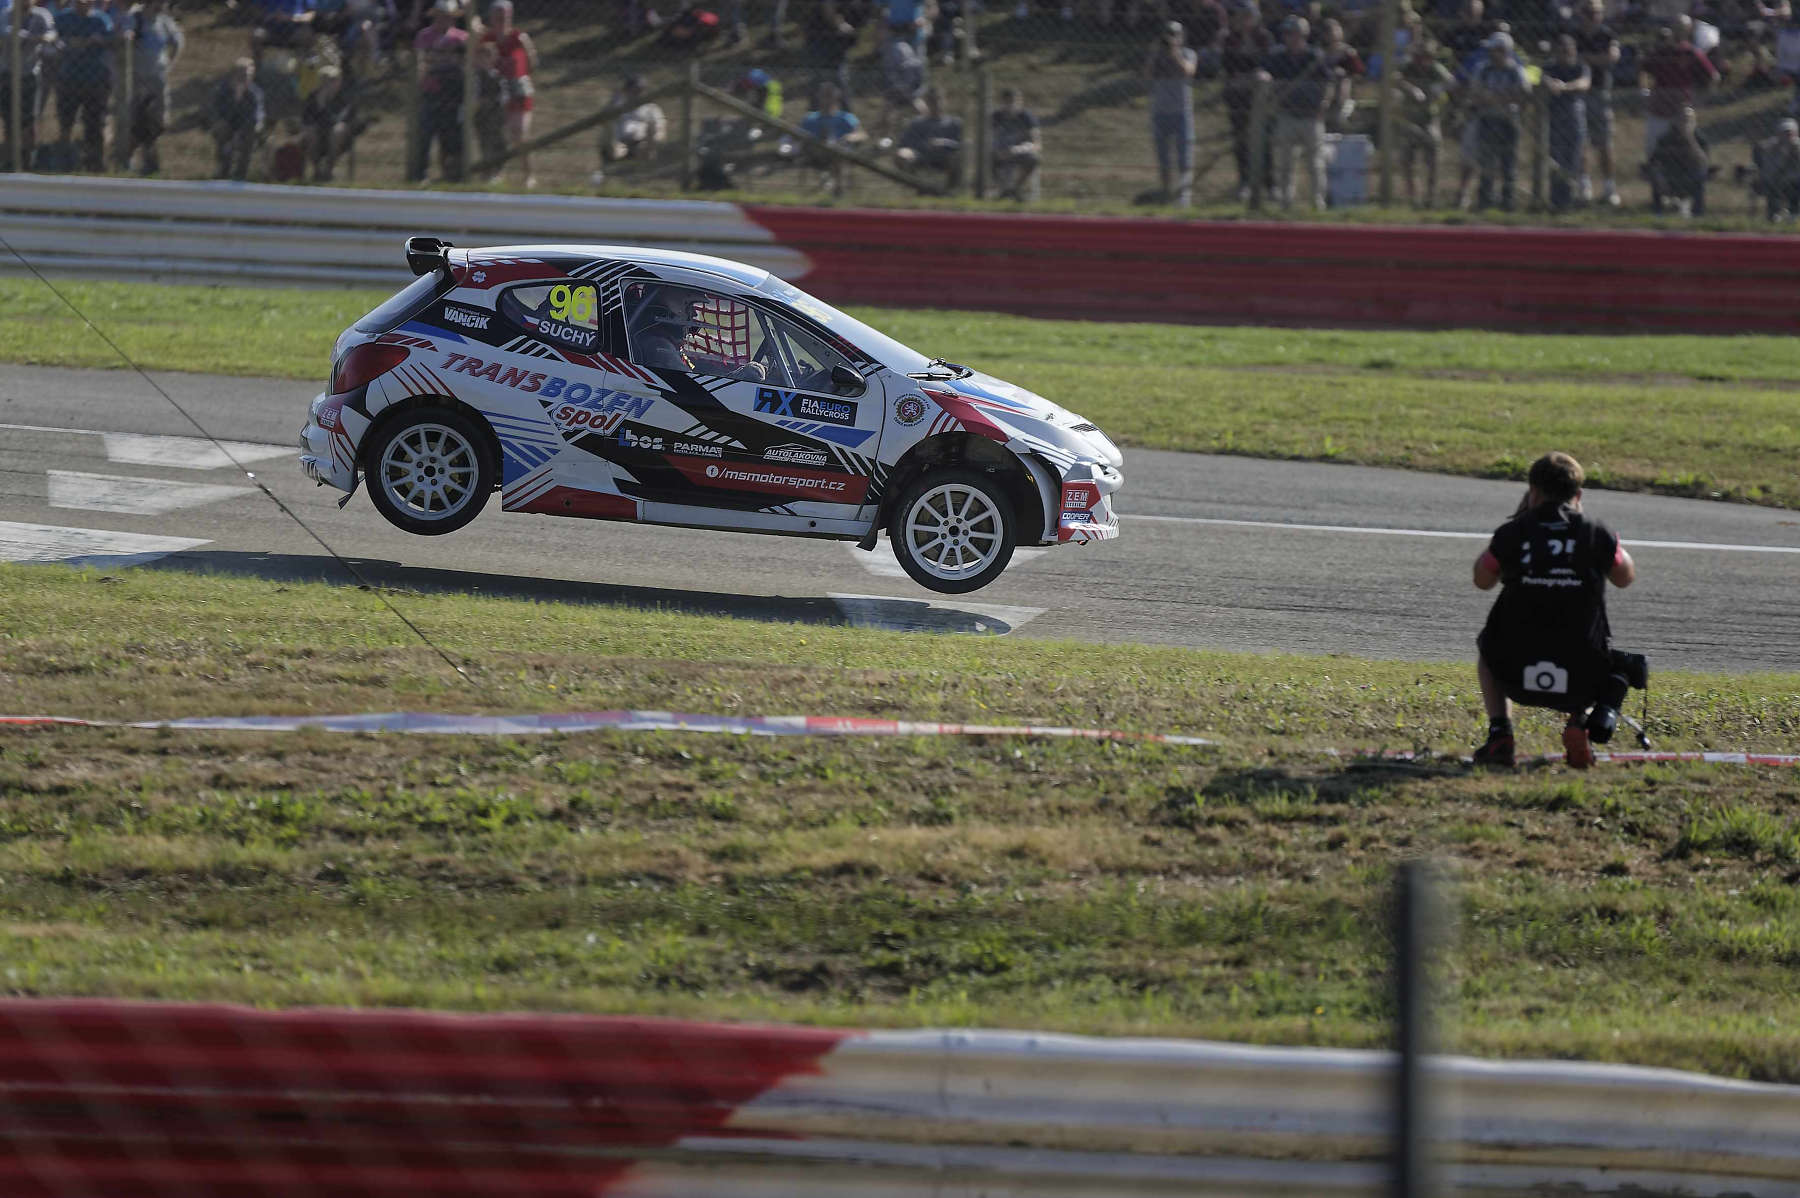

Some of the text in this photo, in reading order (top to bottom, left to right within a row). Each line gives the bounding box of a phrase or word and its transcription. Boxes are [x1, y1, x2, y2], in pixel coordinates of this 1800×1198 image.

[549, 284, 593, 321] 96
[556, 405, 622, 431] spol
[800, 406, 850, 420] RALLYCROSS
[765, 449, 828, 463] AUTOLAKOVNA
[719, 467, 846, 491] /msmotorsport.cz
